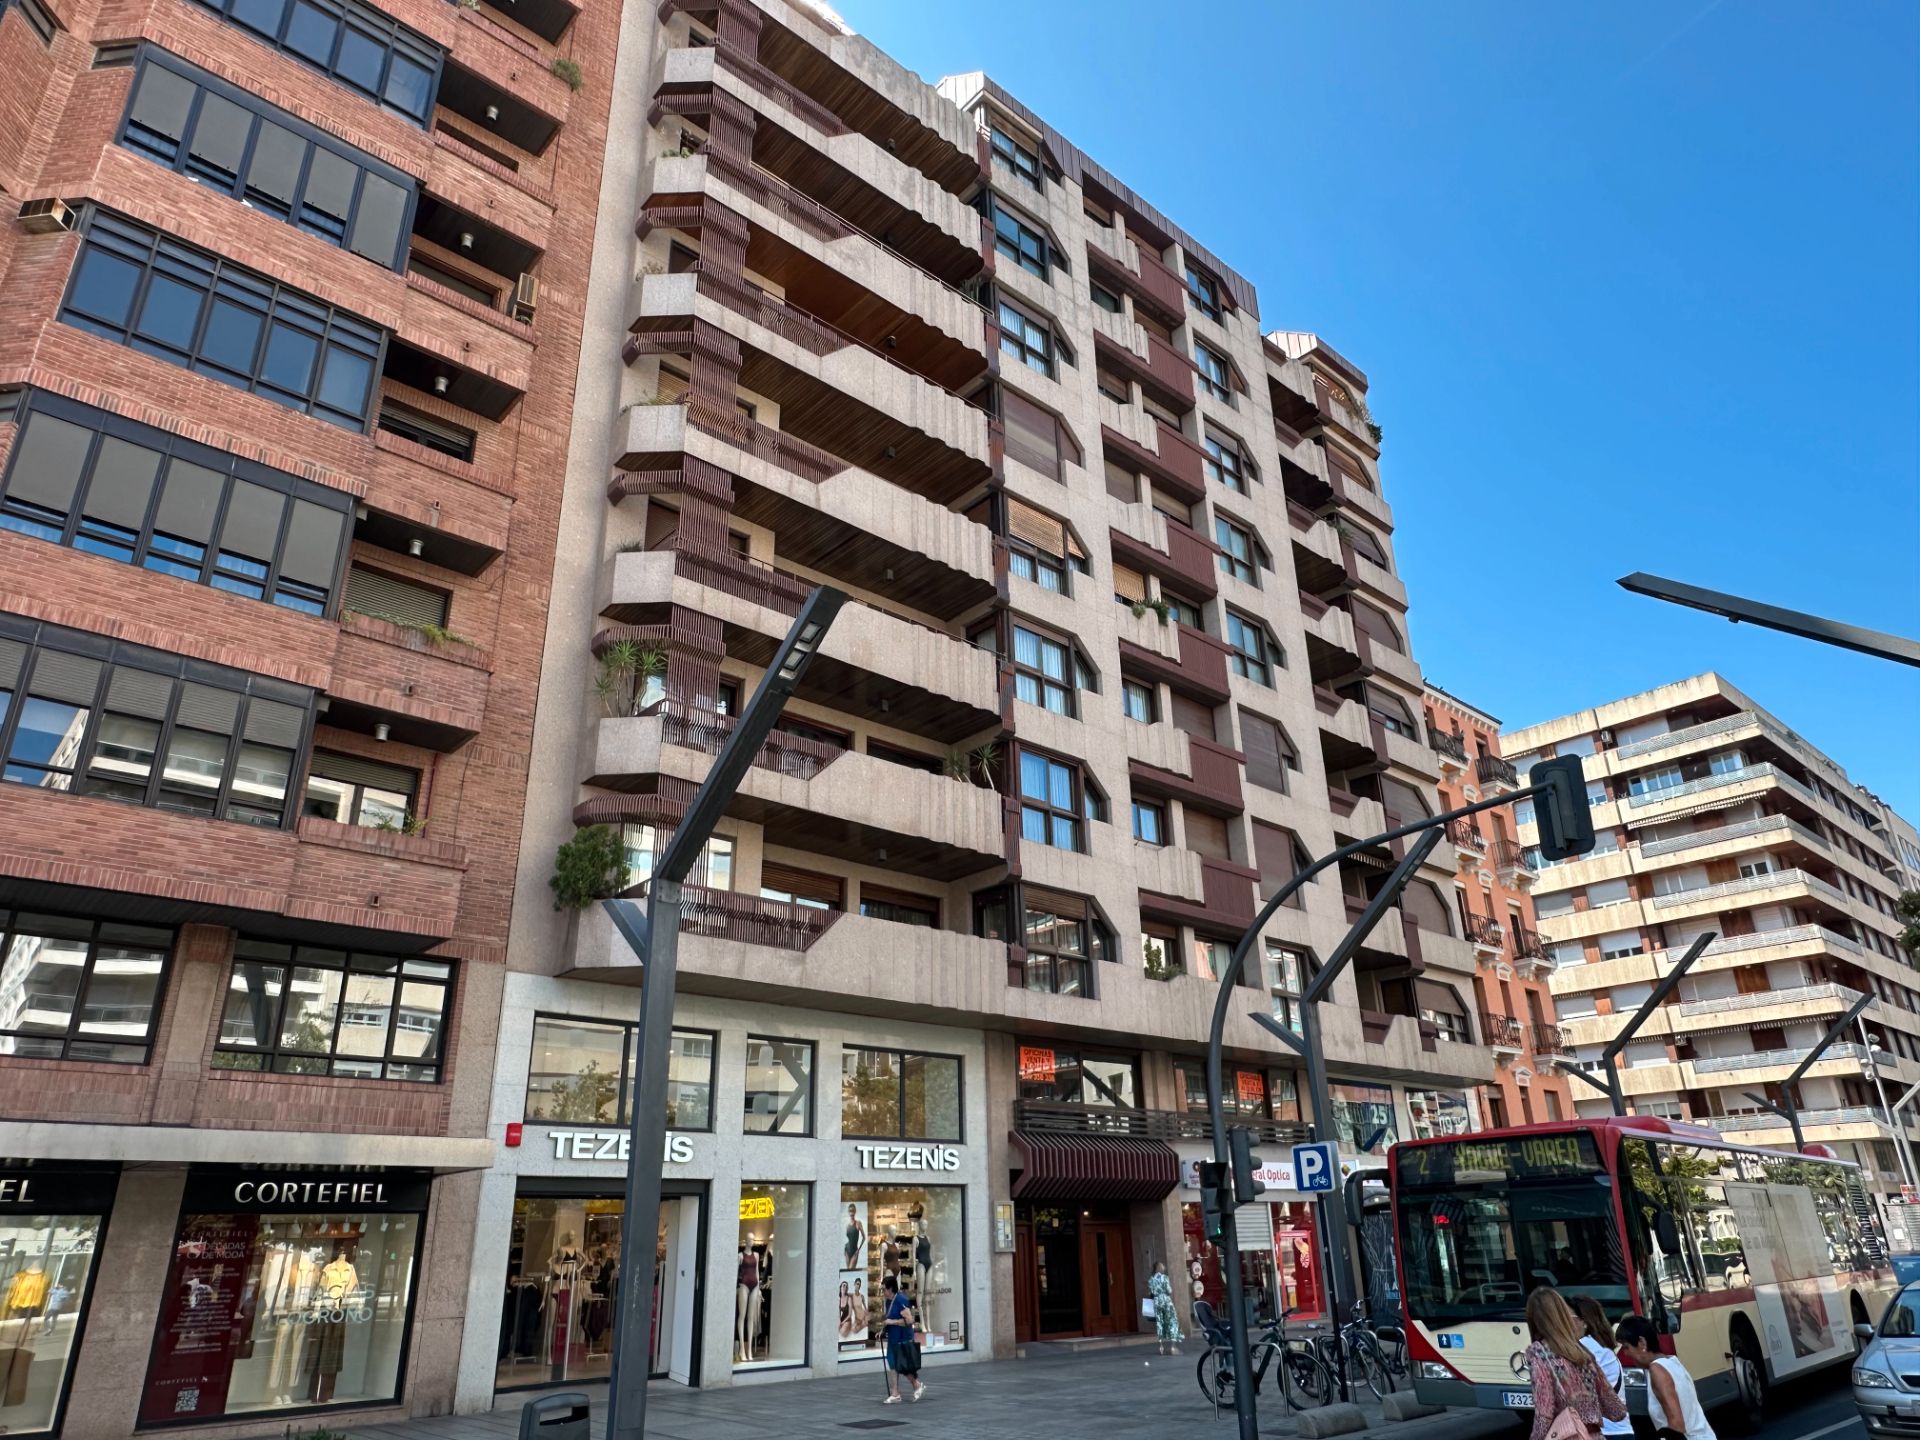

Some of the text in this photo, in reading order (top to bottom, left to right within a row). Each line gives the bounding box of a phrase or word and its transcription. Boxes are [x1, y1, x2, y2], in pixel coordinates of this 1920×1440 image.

[1370, 1105, 1388, 1125] 25
[549, 1131, 695, 1163] TEZEIS
[856, 1144, 961, 1171] TEZENIS
[1300, 1150, 1323, 1188] P
[1416, 1150, 1431, 1175] 2
[1266, 1168, 1291, 1183] Optica
[234, 1181, 389, 1204] CORTEFIEL
